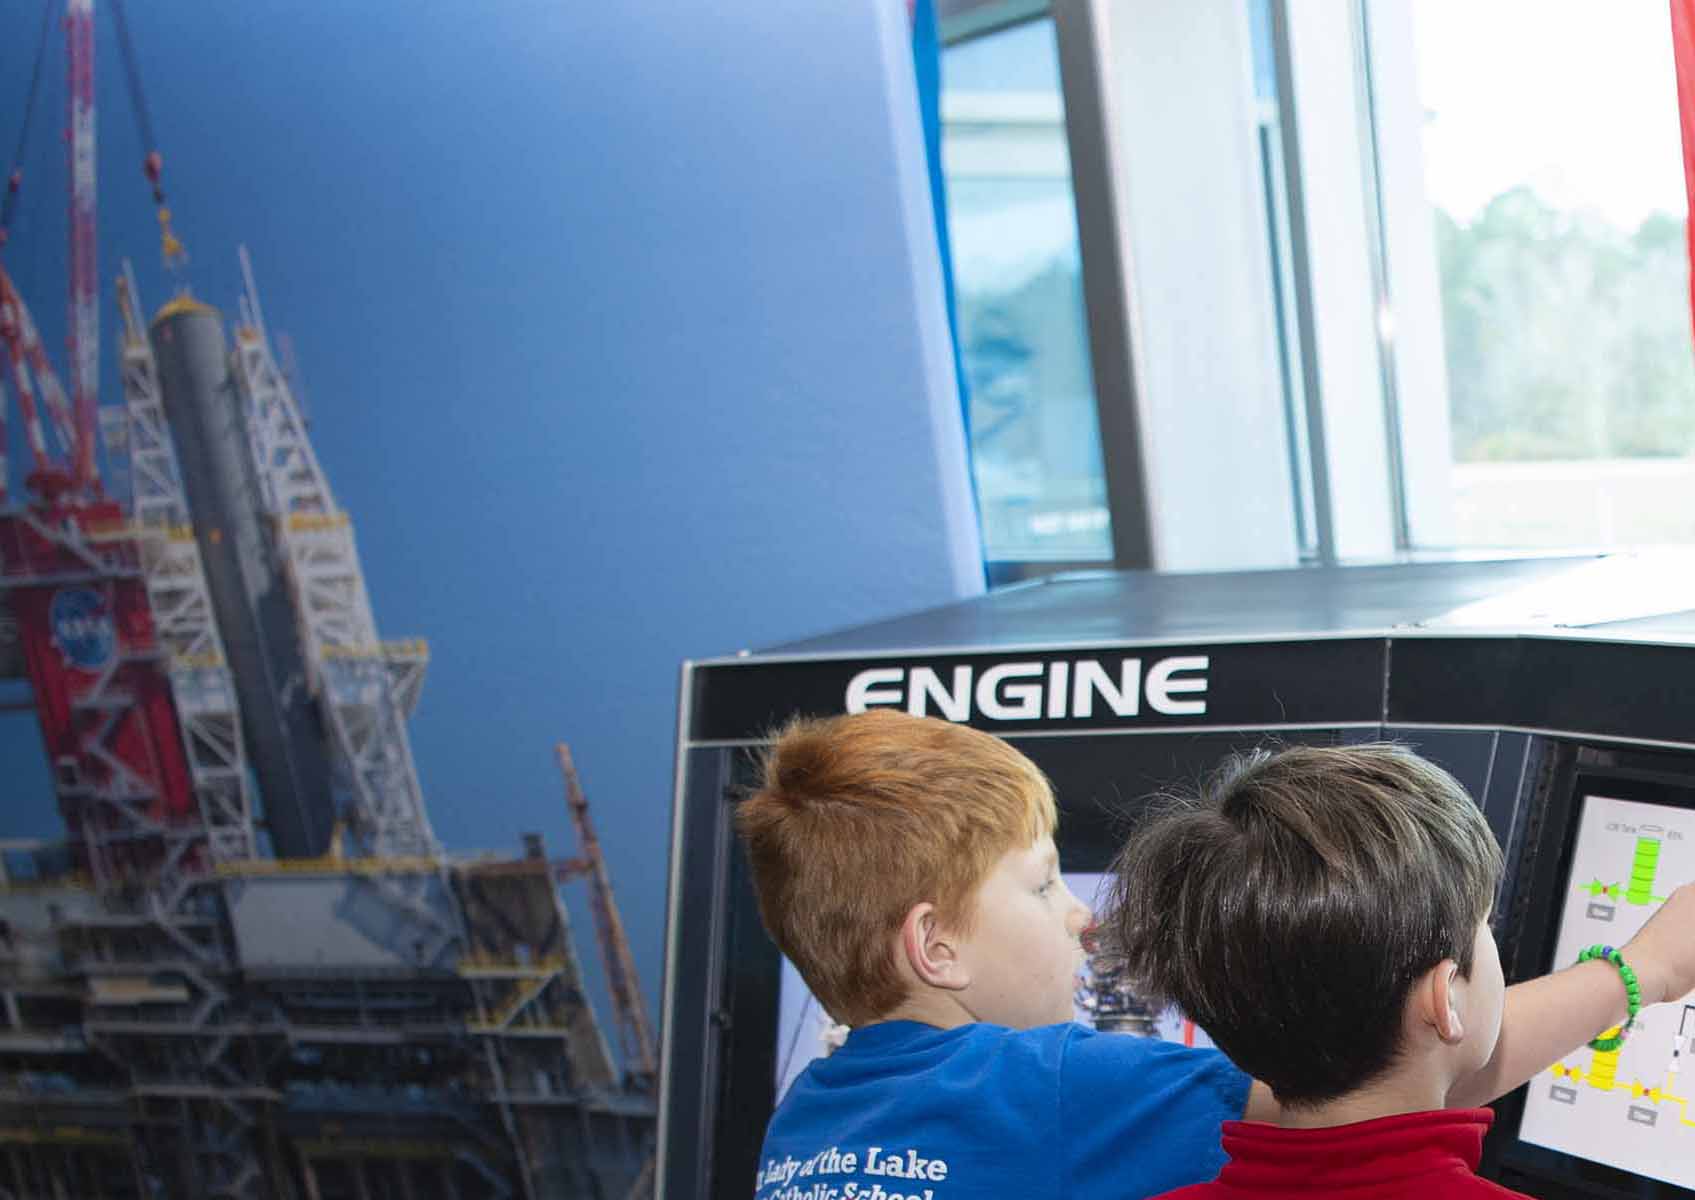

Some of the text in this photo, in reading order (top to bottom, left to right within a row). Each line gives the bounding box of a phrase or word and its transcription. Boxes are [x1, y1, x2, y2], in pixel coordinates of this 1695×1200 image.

[845, 655, 1210, 722] ENGINE
[764, 1155, 801, 1187] Lady
[818, 1146, 858, 1175] the
[864, 1147, 949, 1182] Lake
